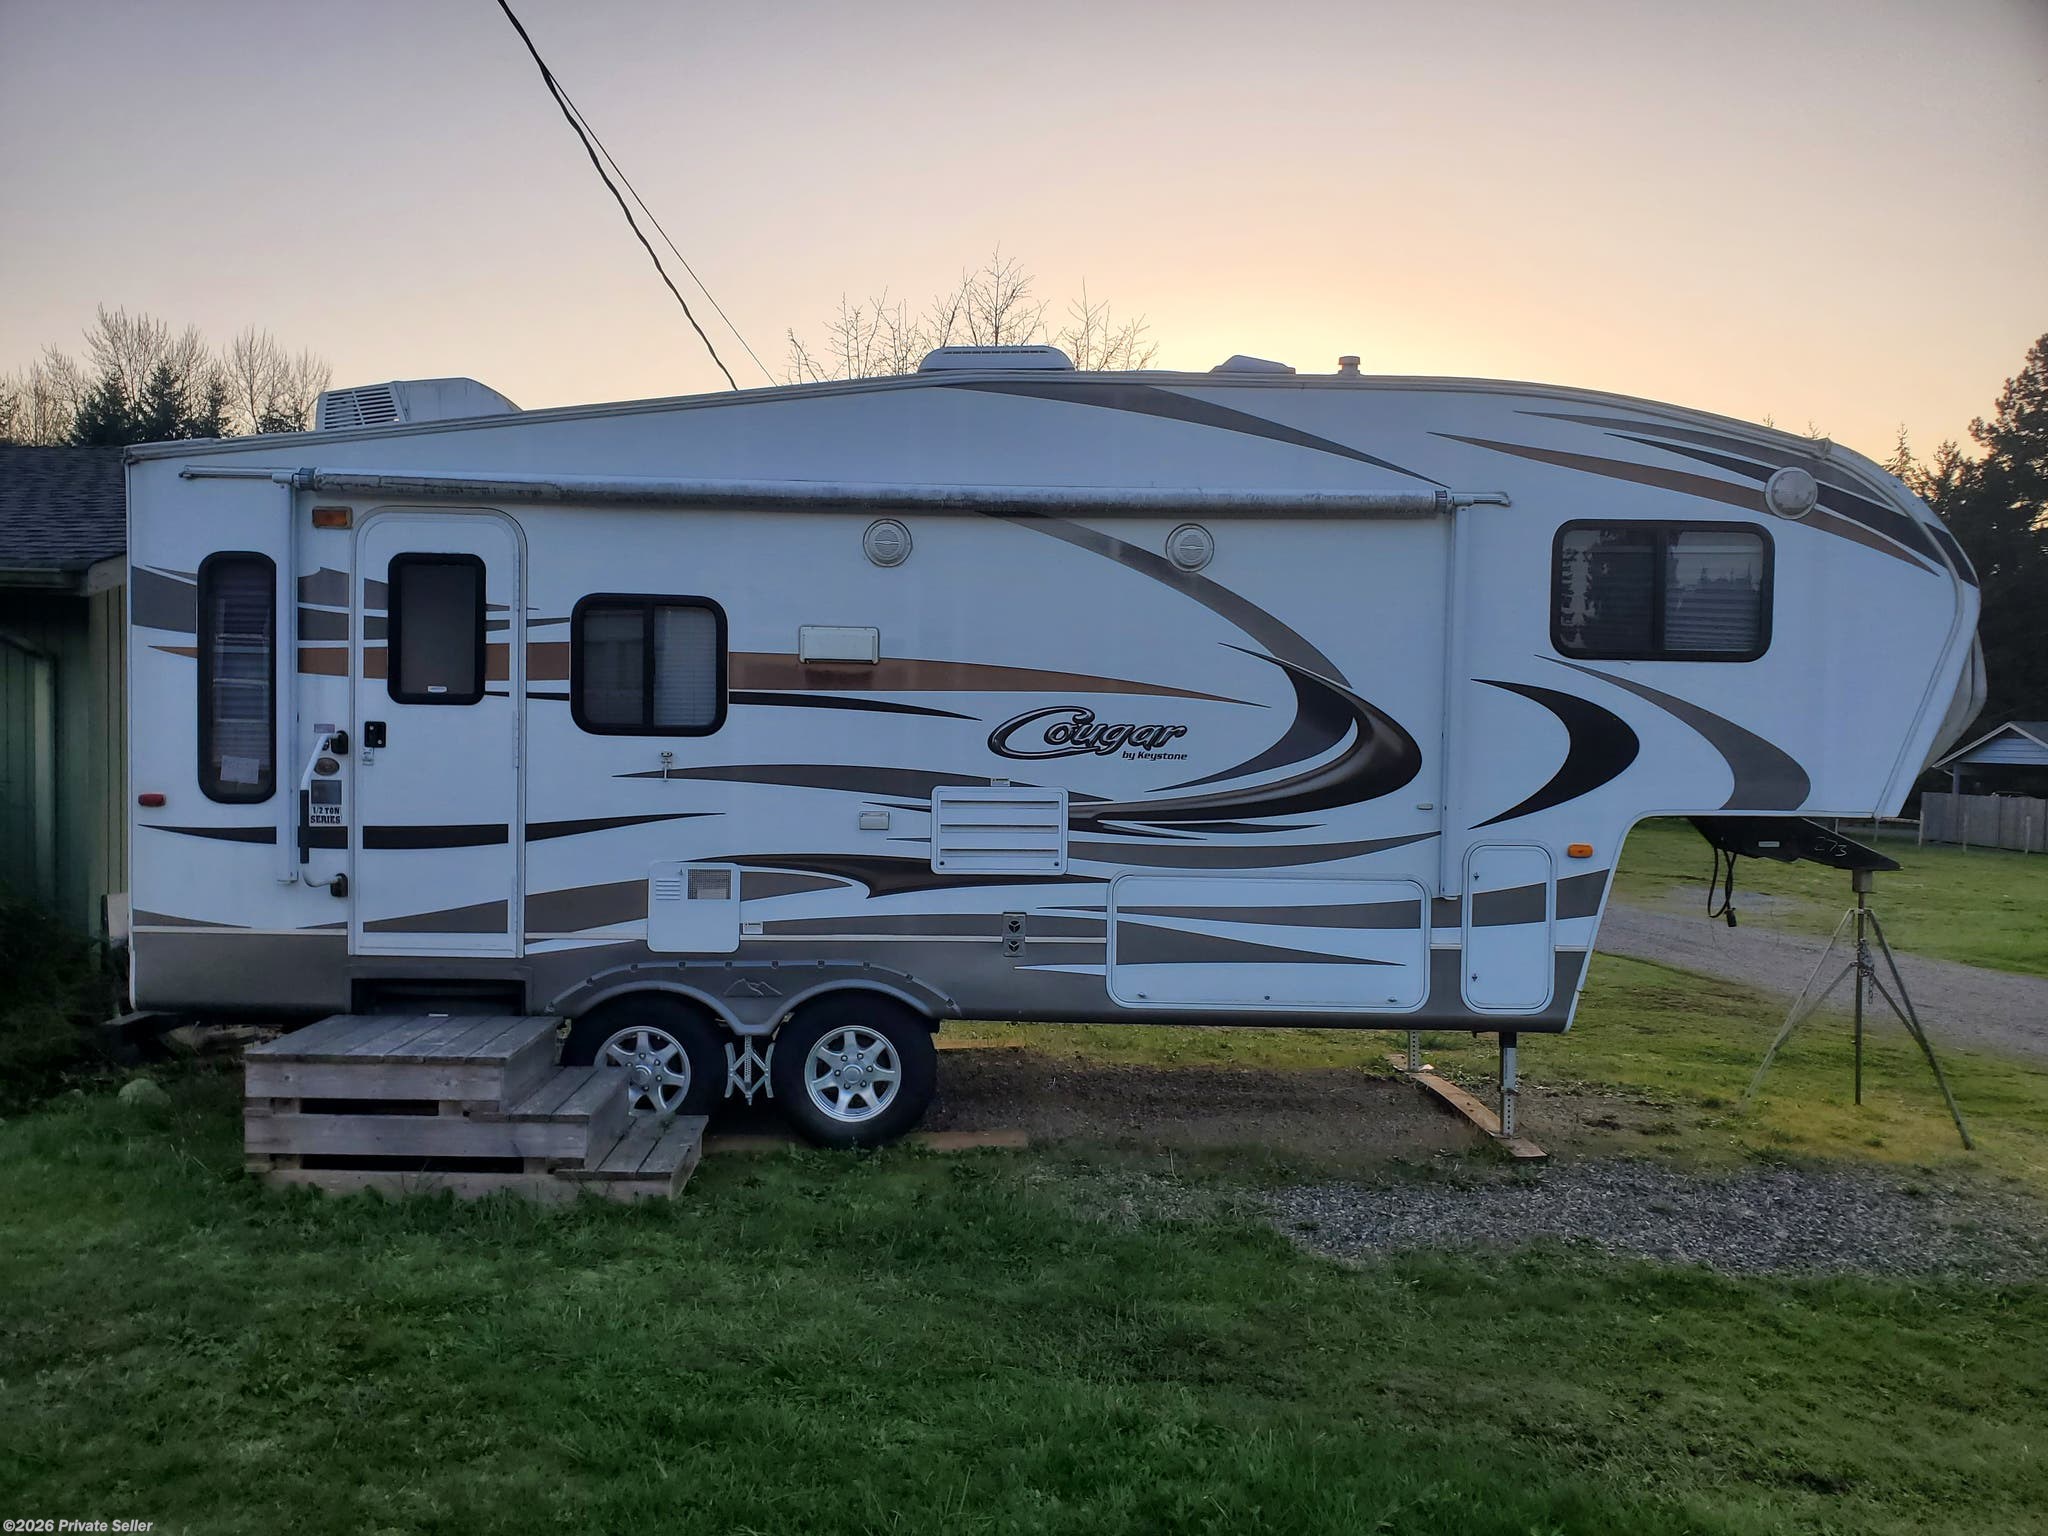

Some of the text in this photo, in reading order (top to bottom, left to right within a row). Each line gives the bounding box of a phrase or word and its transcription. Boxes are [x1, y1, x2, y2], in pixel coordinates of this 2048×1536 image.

[987, 705, 1187, 760] Cougar
[1122, 751, 1188, 761] by Keystone
[313, 807, 340, 815] 1/2 TON
[310, 815, 341, 824] SERIES
